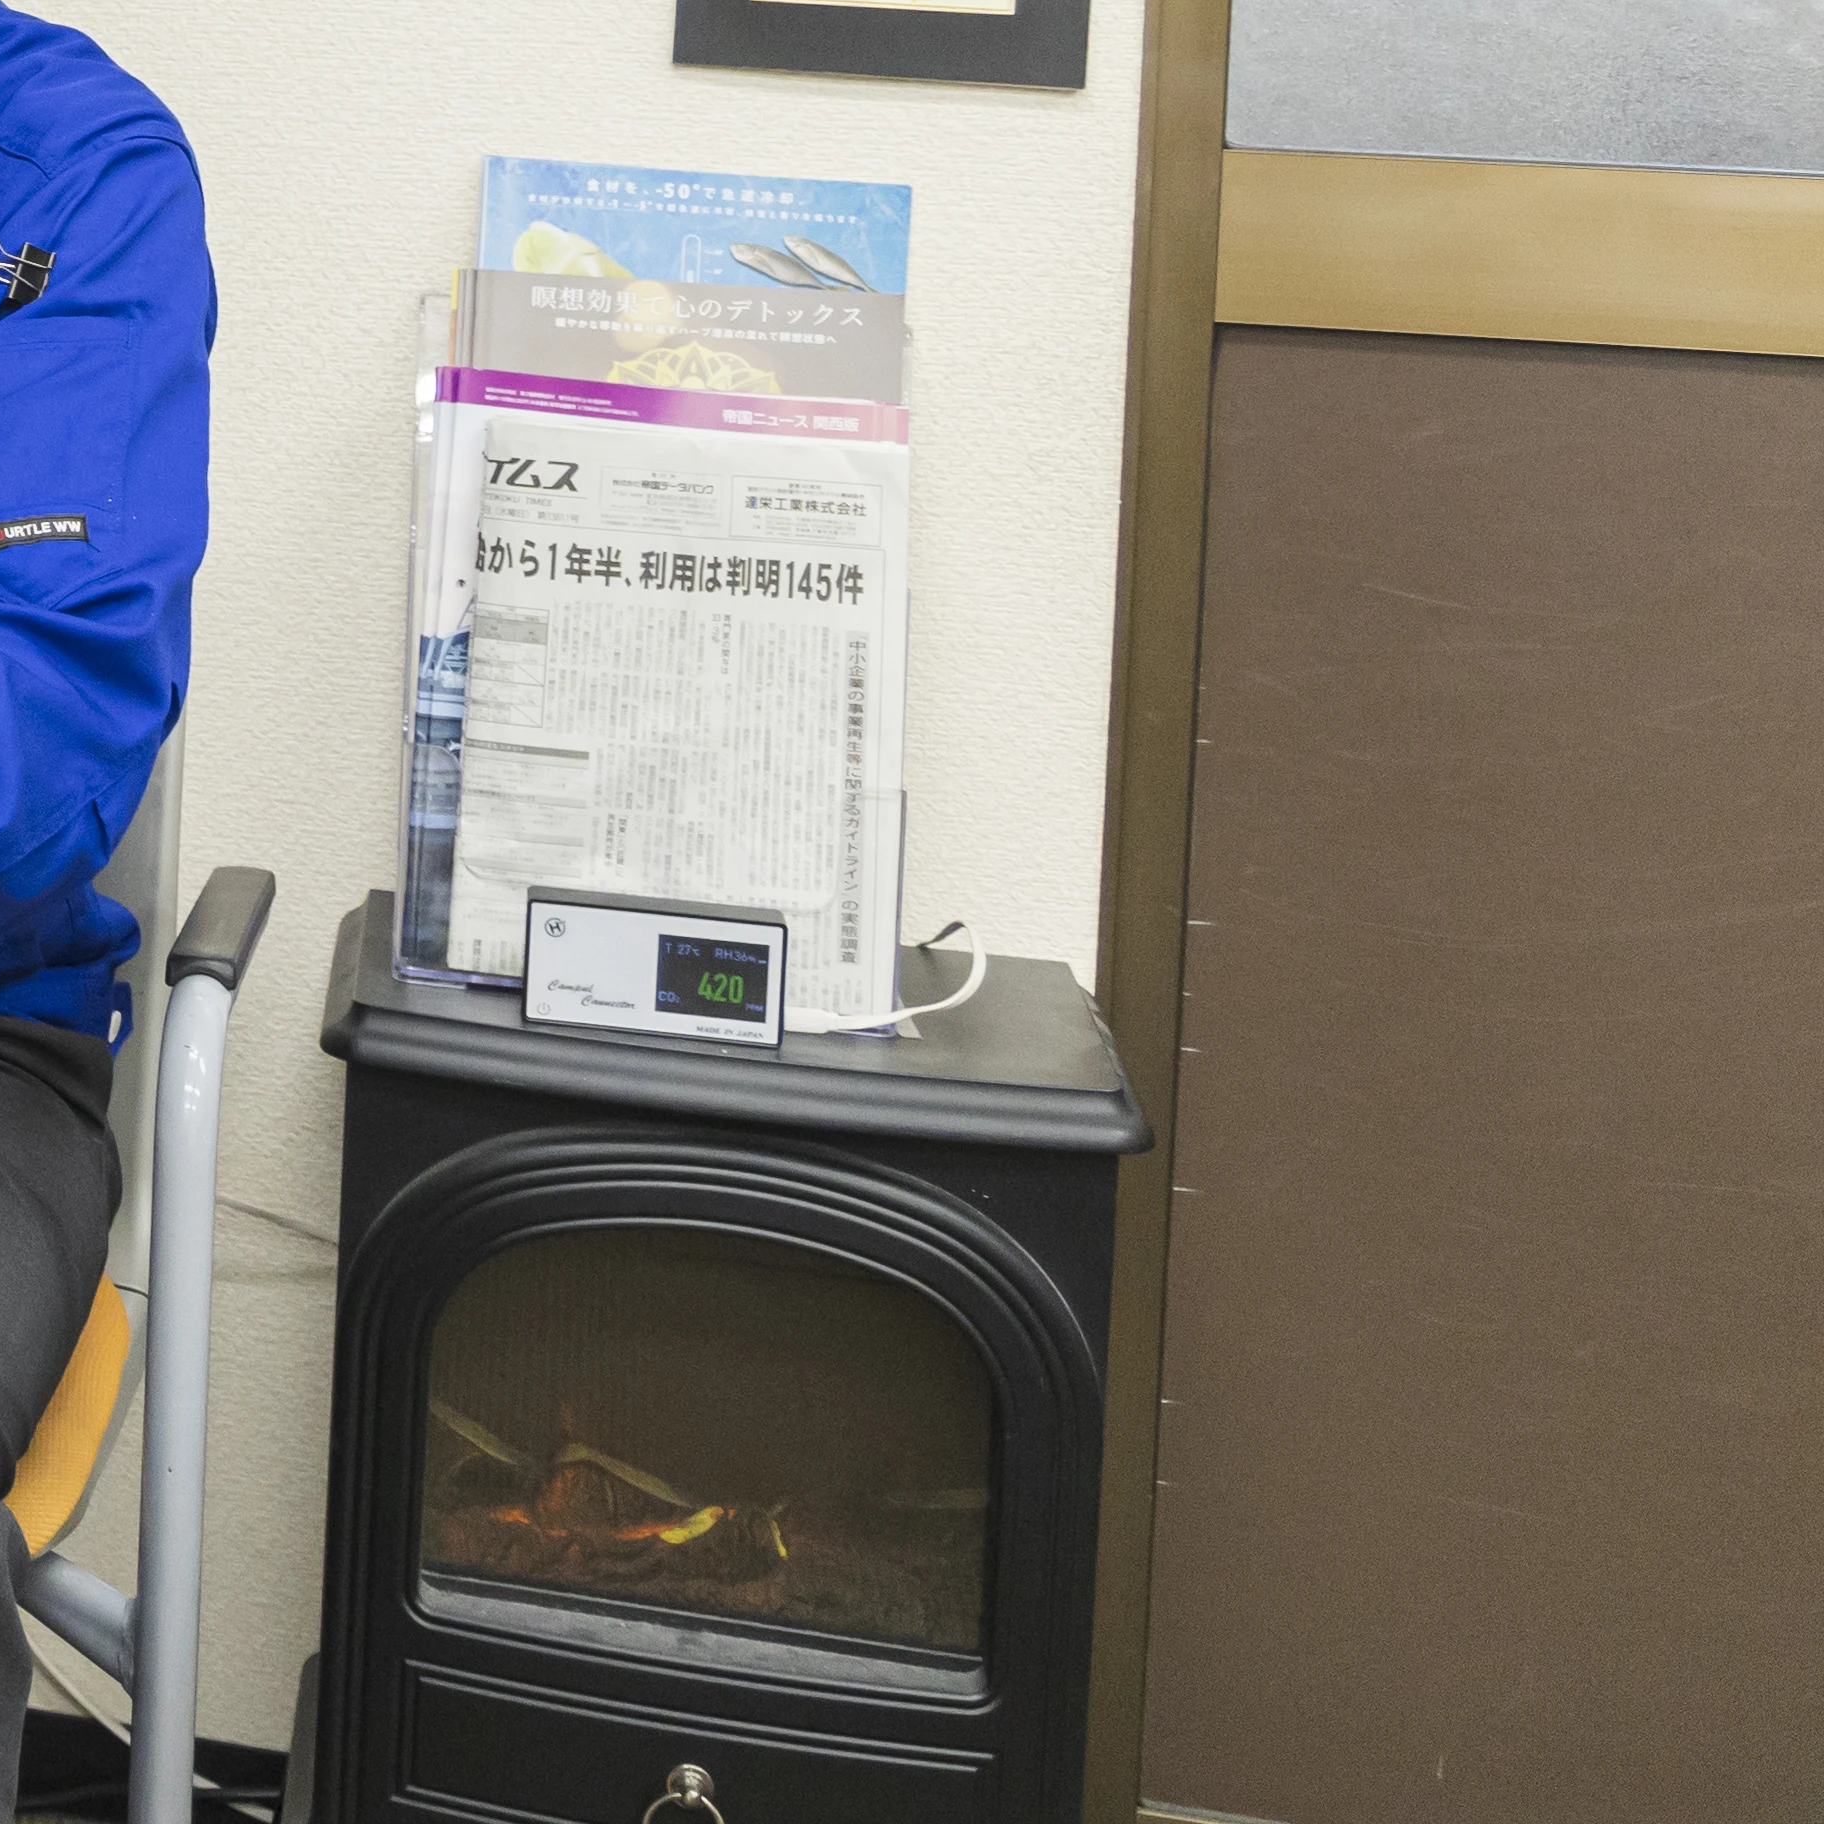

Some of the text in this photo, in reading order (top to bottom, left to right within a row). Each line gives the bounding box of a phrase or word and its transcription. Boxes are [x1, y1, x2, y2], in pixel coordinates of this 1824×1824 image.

[722, 408, 808, 429] 帝国ニュース
[53, 520, 81, 533] WW
[698, 971, 745, 1005] 420
